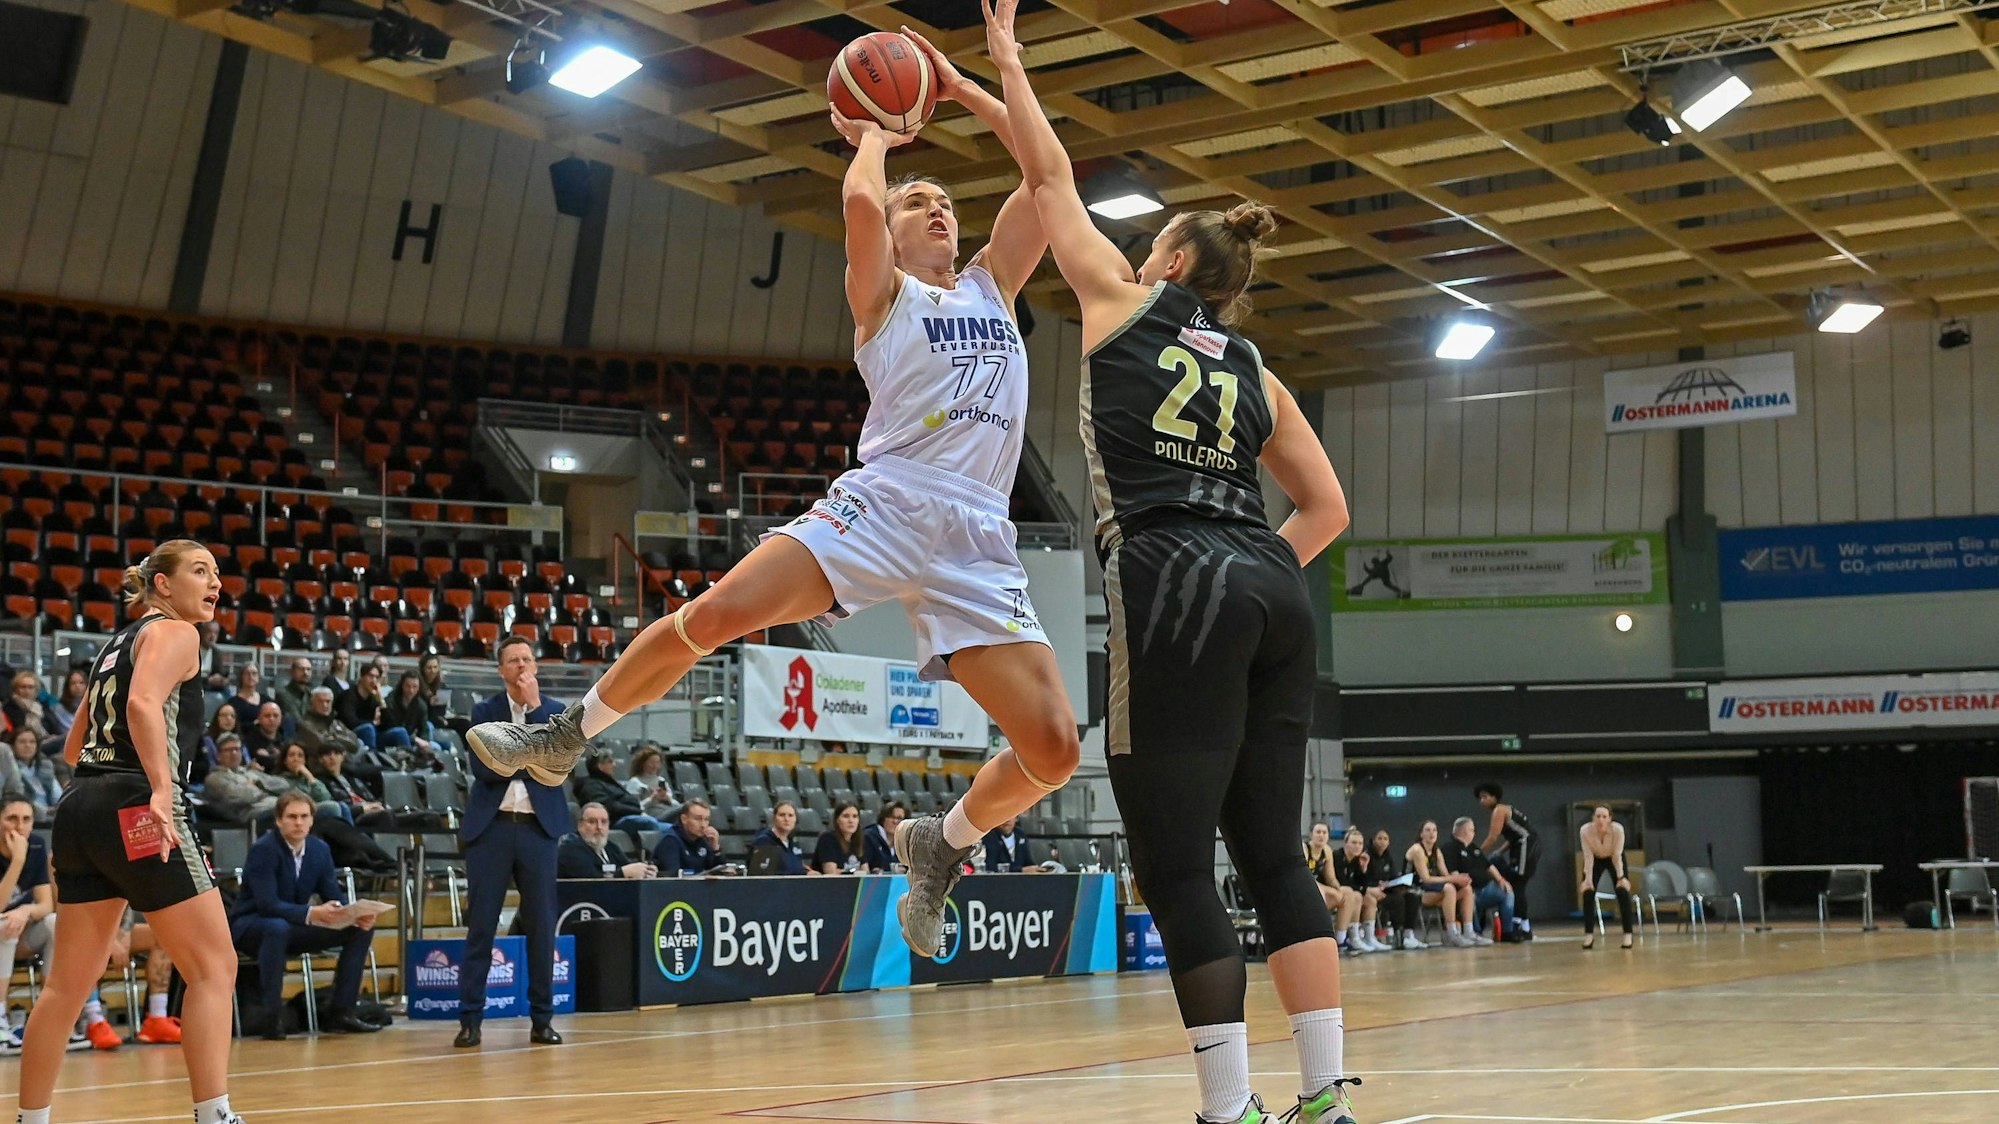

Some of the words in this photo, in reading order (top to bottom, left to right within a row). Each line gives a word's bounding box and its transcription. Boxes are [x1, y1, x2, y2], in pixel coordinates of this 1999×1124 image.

[391, 199, 441, 264] H
[750, 231, 784, 289] J
[922, 317, 1018, 345] WINGS
[1195, 330, 1223, 349] Sparkasse
[931, 341, 1020, 356] LEVERKUSEN
[1192, 338, 1219, 356] Hannover
[951, 355, 1008, 401] 77
[1152, 345, 1238, 454] 21
[1155, 441, 1238, 471] POLLERUS
[1772, 545, 1825, 570] EVL
[1839, 541, 1867, 557] Wir
[1872, 539, 1953, 556] versorgen
[1958, 535, 1985, 551] Sie
[85, 674, 117, 749] 11
[822, 698, 868, 716] Apotheke
[1737, 697, 1875, 719] OSTERMANN
[659, 934, 698, 949] BAYER
[713, 908, 824, 976] Bayer
[968, 900, 1054, 960] Bayer
[416, 965, 460, 981] WINGS
